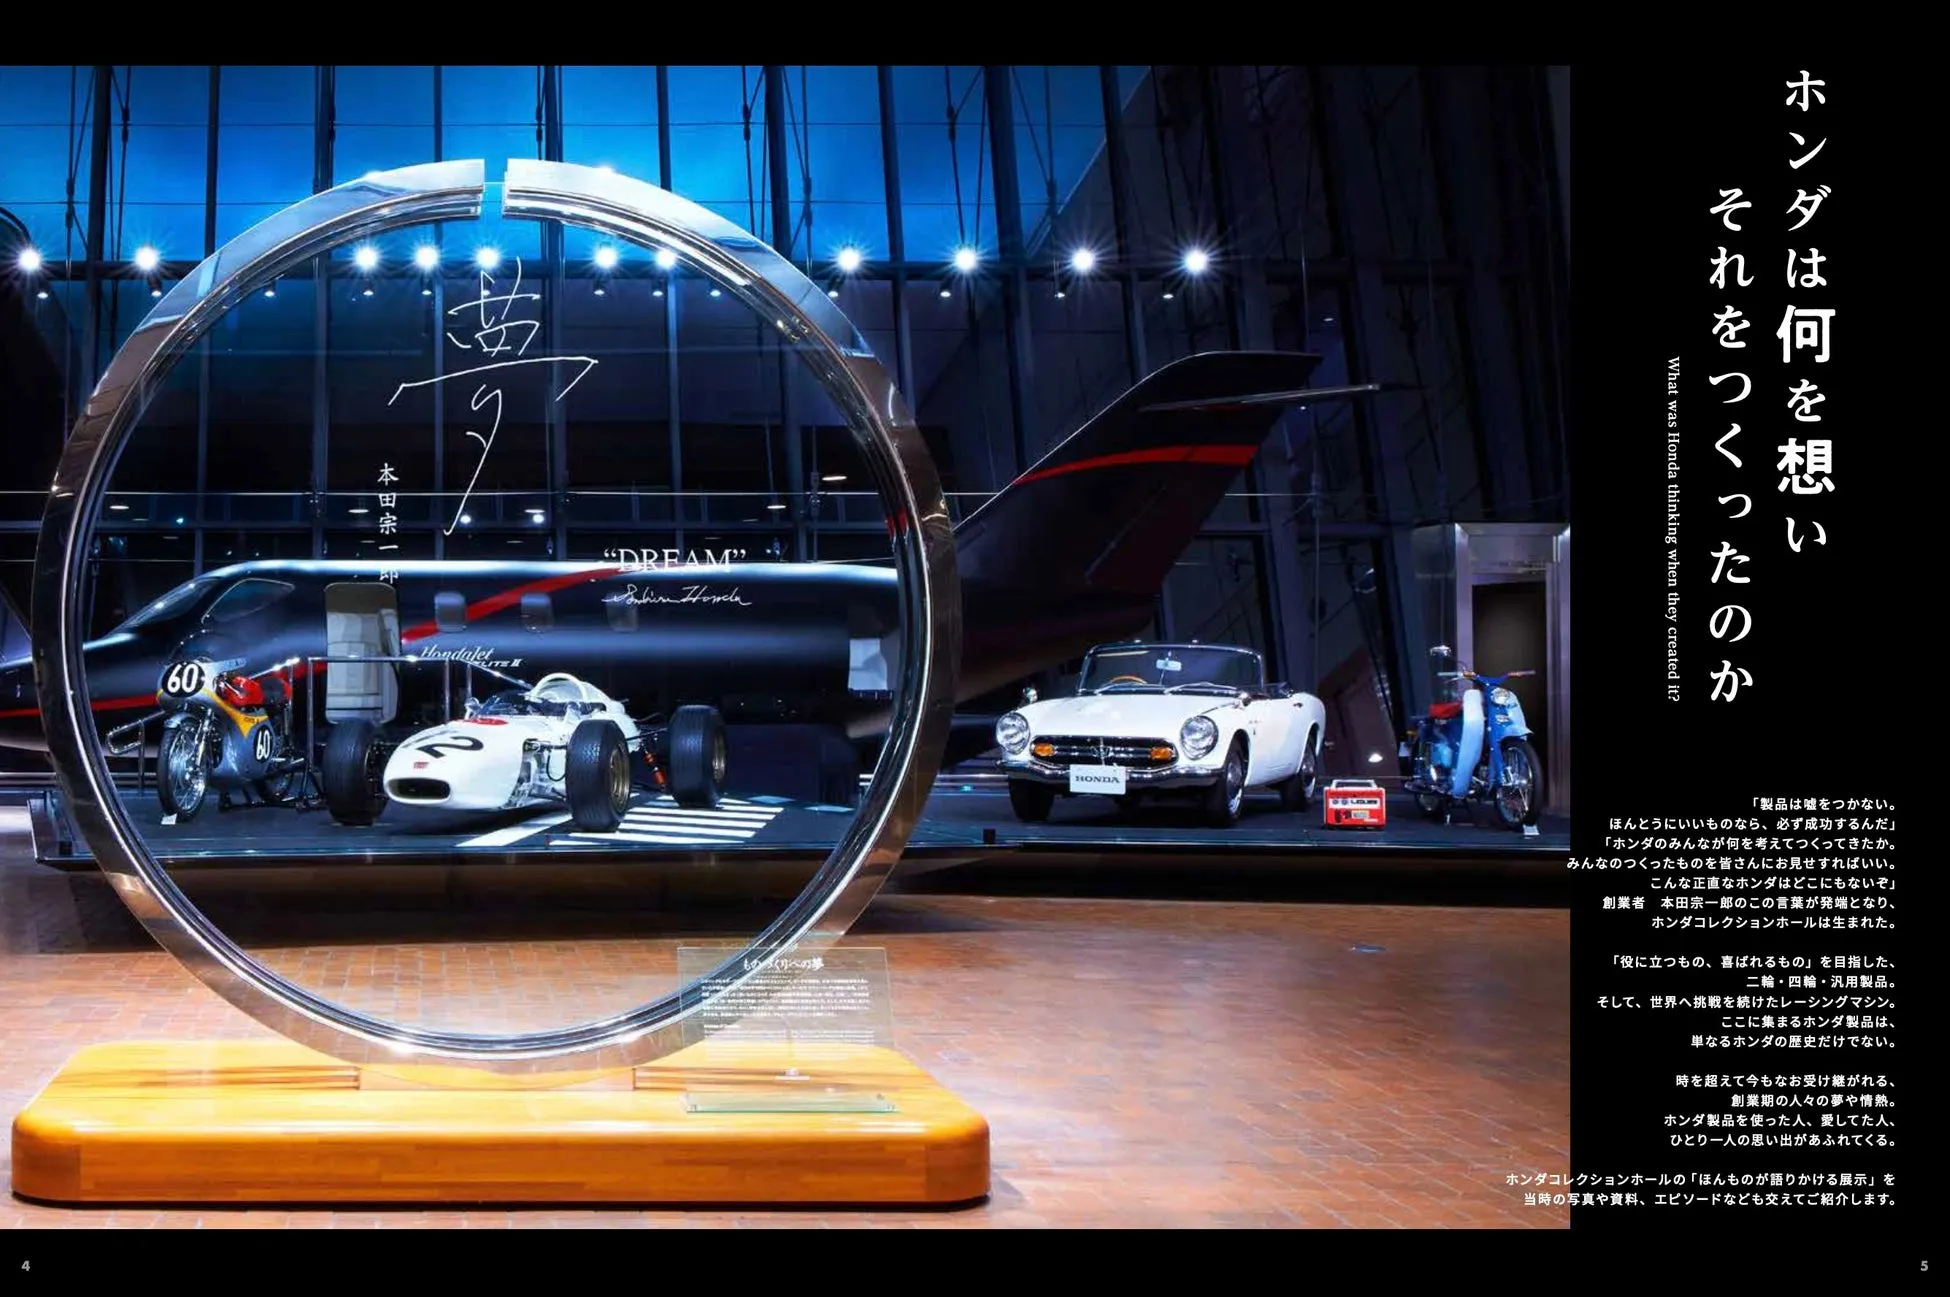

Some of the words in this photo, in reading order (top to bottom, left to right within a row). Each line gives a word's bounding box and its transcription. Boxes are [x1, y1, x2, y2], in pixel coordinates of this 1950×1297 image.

[421, 644, 495, 662] HondaJet
[167, 662, 199, 693] 60
[256, 729, 271, 761] 60
[1075, 774, 1121, 785] HONDA
